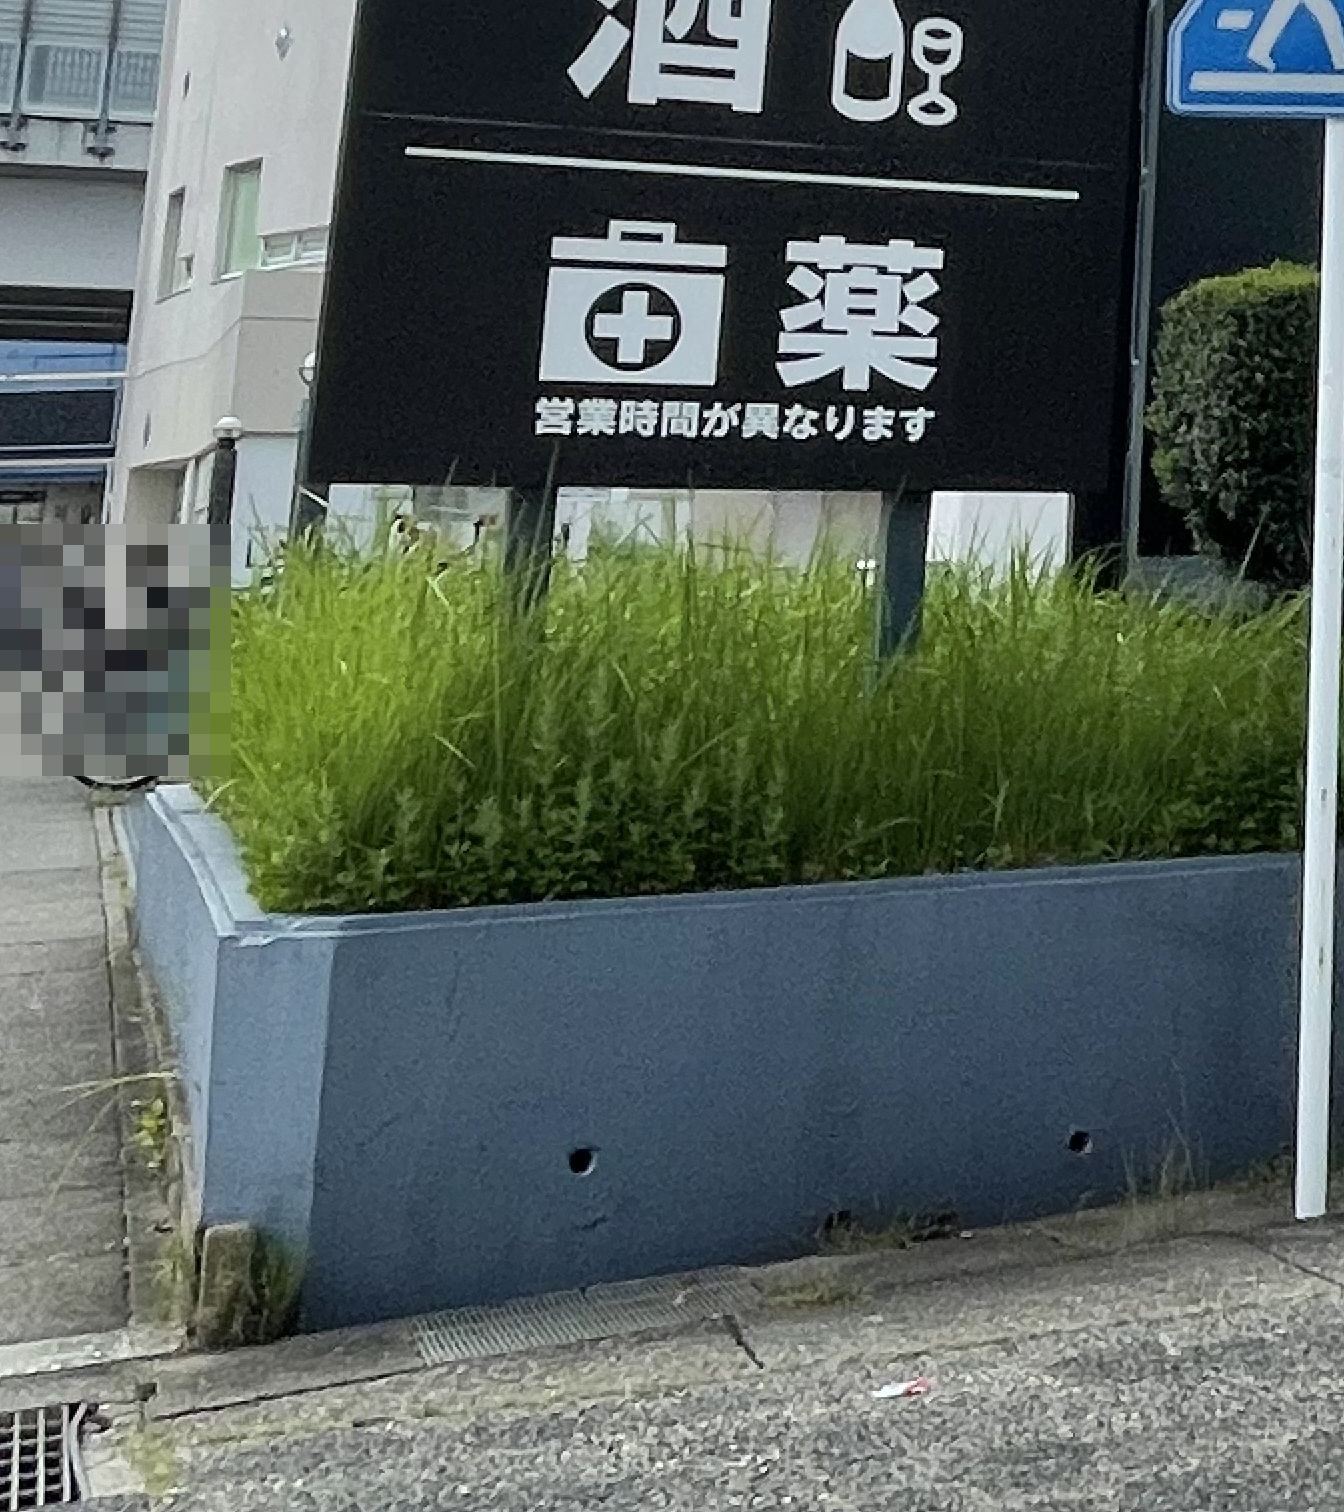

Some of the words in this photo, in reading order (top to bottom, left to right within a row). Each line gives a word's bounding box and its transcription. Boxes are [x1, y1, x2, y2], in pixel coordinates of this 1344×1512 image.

[776, 235, 944, 392] 薬
[534, 396, 936, 442] 営業時間が異なります
